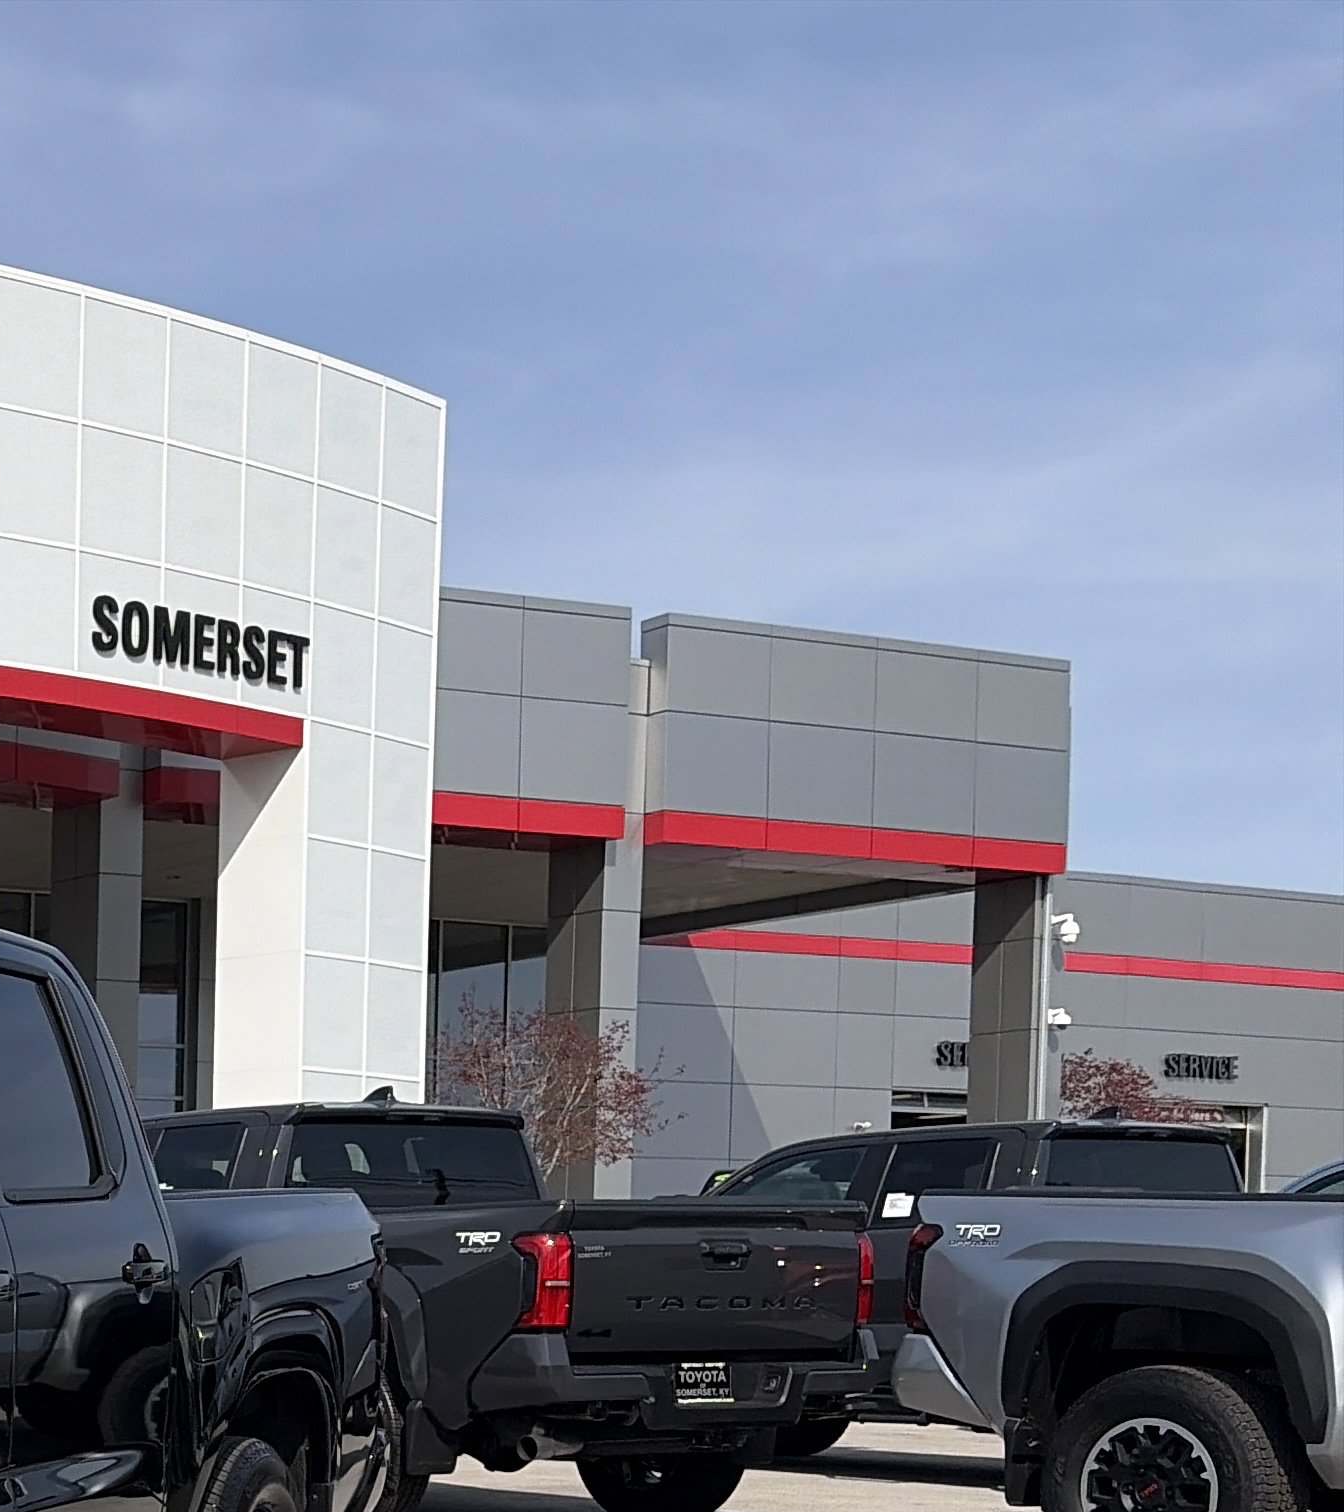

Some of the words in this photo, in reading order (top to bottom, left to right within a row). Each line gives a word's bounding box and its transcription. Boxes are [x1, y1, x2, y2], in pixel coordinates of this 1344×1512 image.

[92, 595, 310, 690] SOMERSET
[936, 1040, 968, 1067] SE
[1164, 1053, 1239, 1080] SERVICE
[455, 1231, 501, 1246] TRD
[955, 1224, 1001, 1240] TRD
[626, 1295, 817, 1312] TACOMA
[678, 1370, 727, 1384] TOYOTA
[719, 1388, 730, 1397] KY
